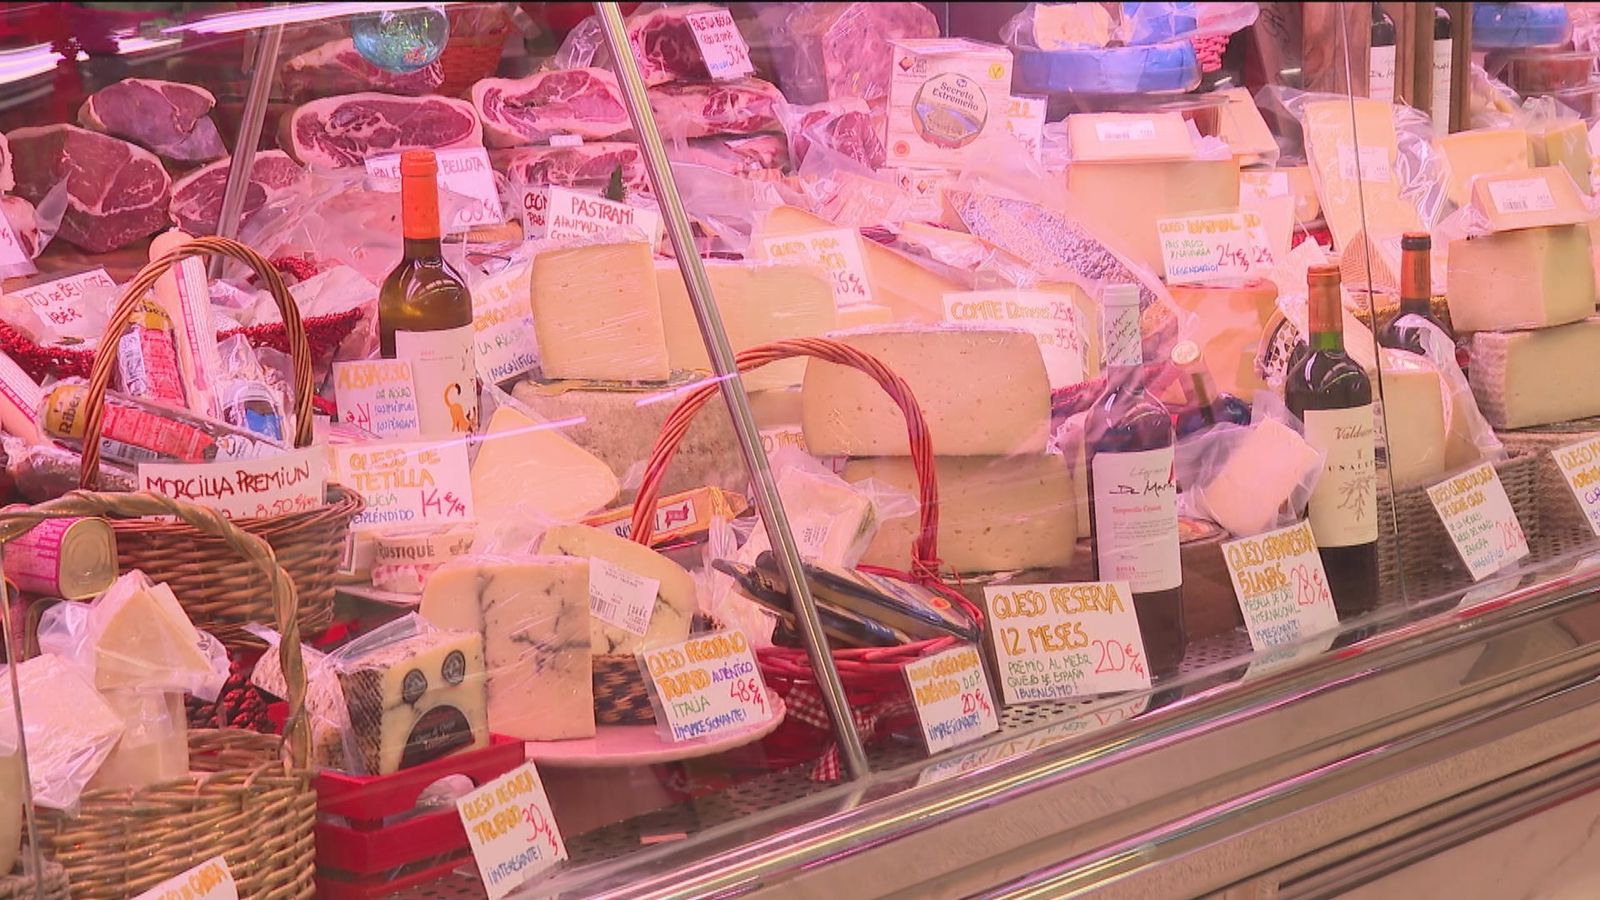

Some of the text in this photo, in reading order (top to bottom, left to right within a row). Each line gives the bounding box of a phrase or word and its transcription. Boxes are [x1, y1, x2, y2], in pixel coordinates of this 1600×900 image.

[932, 87, 979, 112] Extremeño
[940, 82, 974, 101] Secreto
[442, 157, 485, 175] BELLOTA
[571, 196, 635, 225] PASTRAMI
[418, 448, 442, 466] DE
[146, 460, 310, 500] MORCILLA PREMIUN
[351, 469, 436, 492] TETILLA
[1227, 540, 1265, 572] QUESO
[992, 583, 1126, 620] QUESO RESERVA
[1001, 627, 1027, 657] 12
[1027, 621, 1090, 653] MESES
[648, 648, 686, 677] QUESO
[1008, 658, 1045, 676] PREMIO
[1049, 657, 1062, 671] AL
